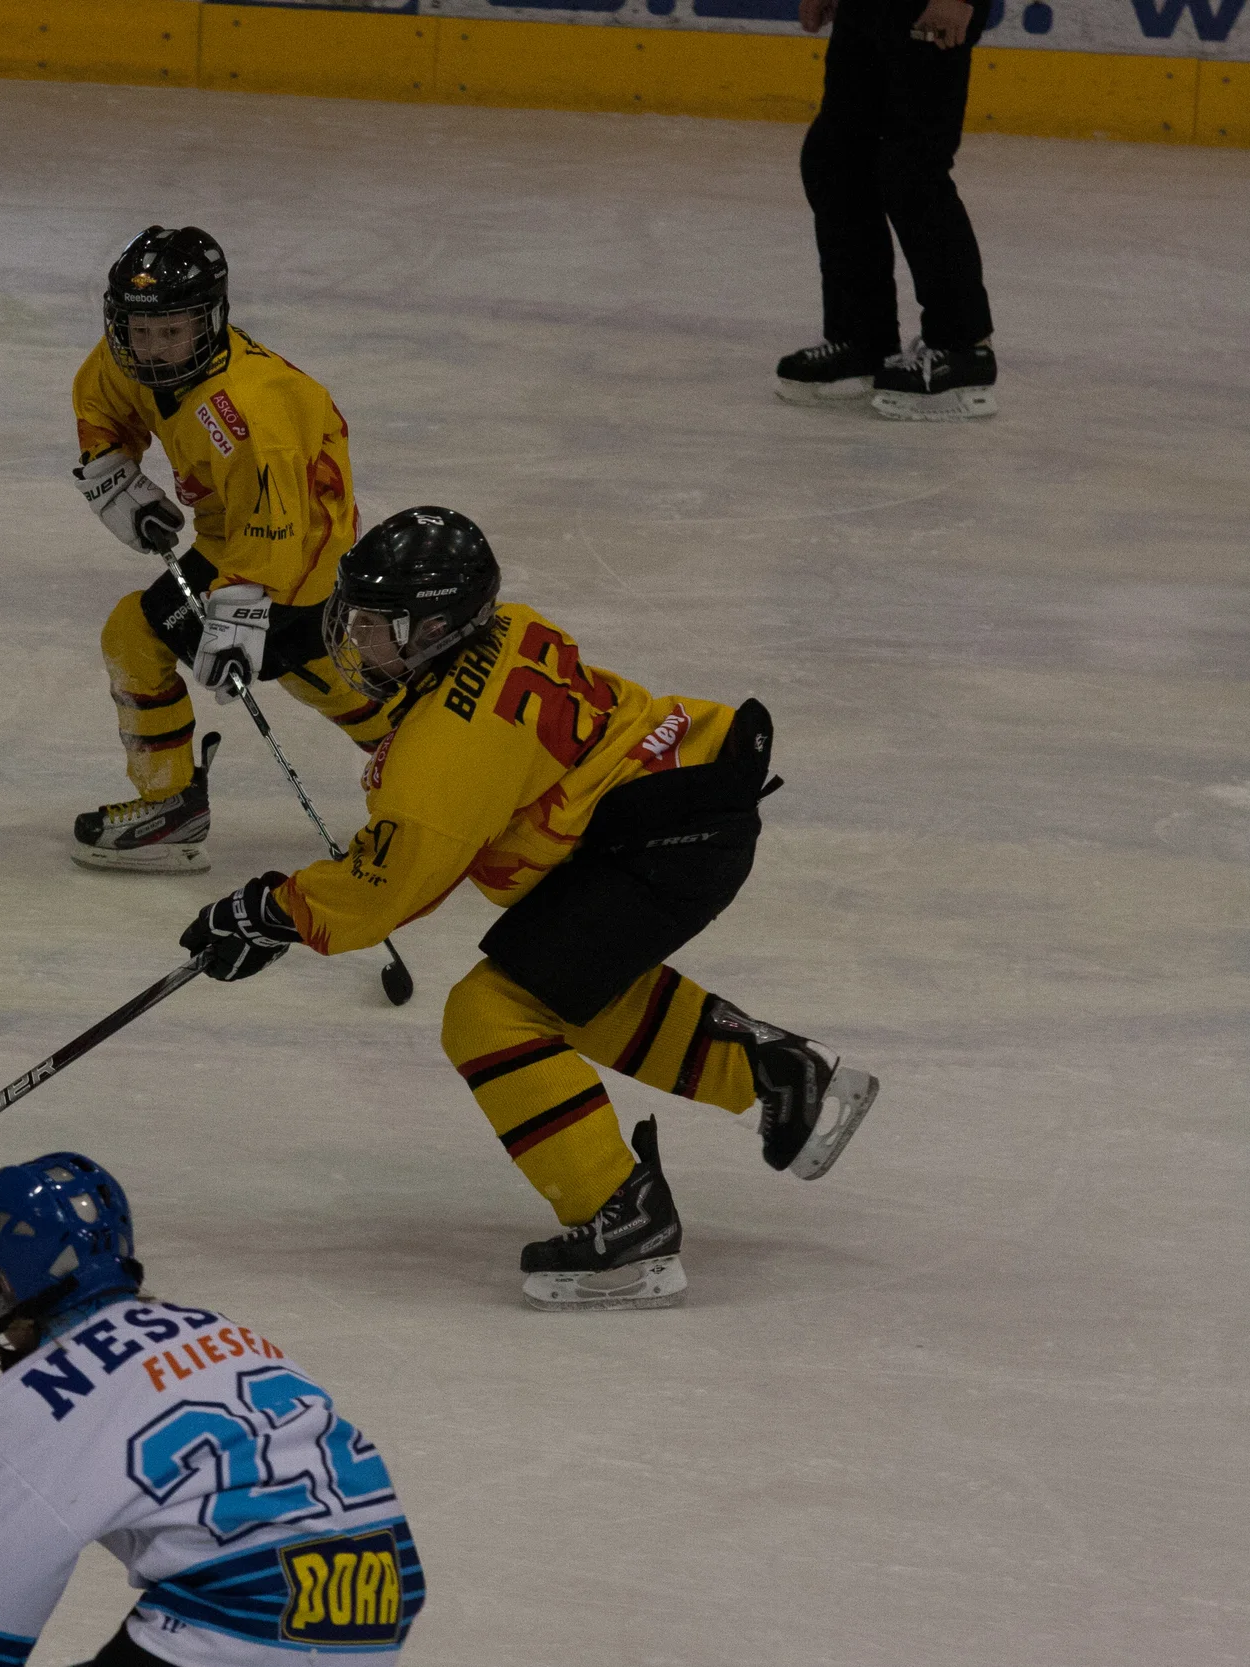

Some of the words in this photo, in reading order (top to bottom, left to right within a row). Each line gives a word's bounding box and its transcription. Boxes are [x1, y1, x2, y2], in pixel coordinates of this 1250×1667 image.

[124, 293, 159, 303] Reebok
[213, 394, 238, 425] ASKÖ
[197, 406, 233, 455] RICOH
[83, 467, 127, 502] AUER
[232, 608, 270, 619] BAU
[493, 621, 619, 769] 22
[21, 1303, 219, 1422] NESS
